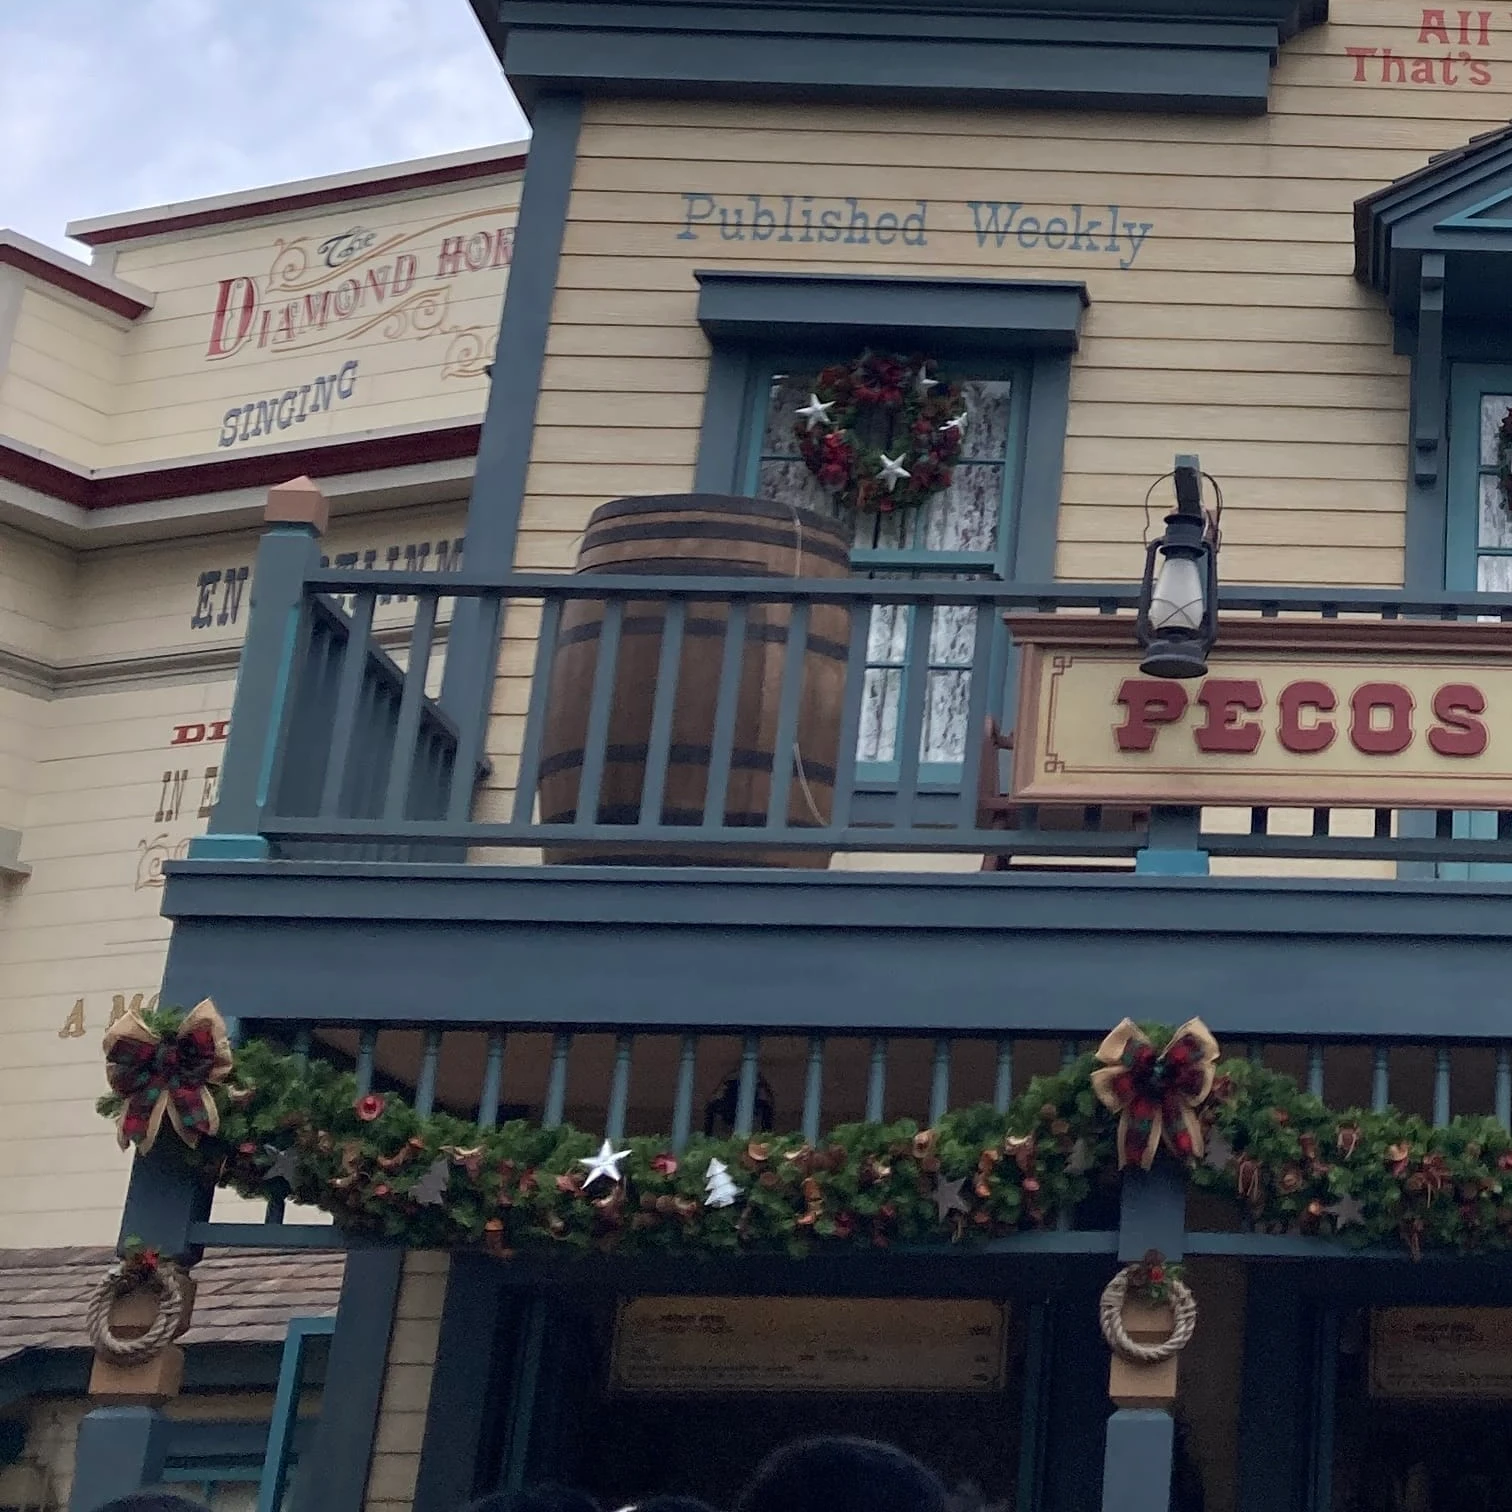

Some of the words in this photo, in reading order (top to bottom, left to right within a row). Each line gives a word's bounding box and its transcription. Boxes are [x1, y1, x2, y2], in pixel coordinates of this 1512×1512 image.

[1417, 9, 1493, 47] All
[1345, 46, 1492, 86] That's
[317, 226, 377, 268] The
[676, 192, 928, 246] Published
[966, 200, 1154, 270] Weekly
[205, 253, 418, 362] DIAMOND
[218, 359, 360, 447] SINGING
[1112, 676, 1490, 759] PECOS
[154, 769, 189, 823] IN
